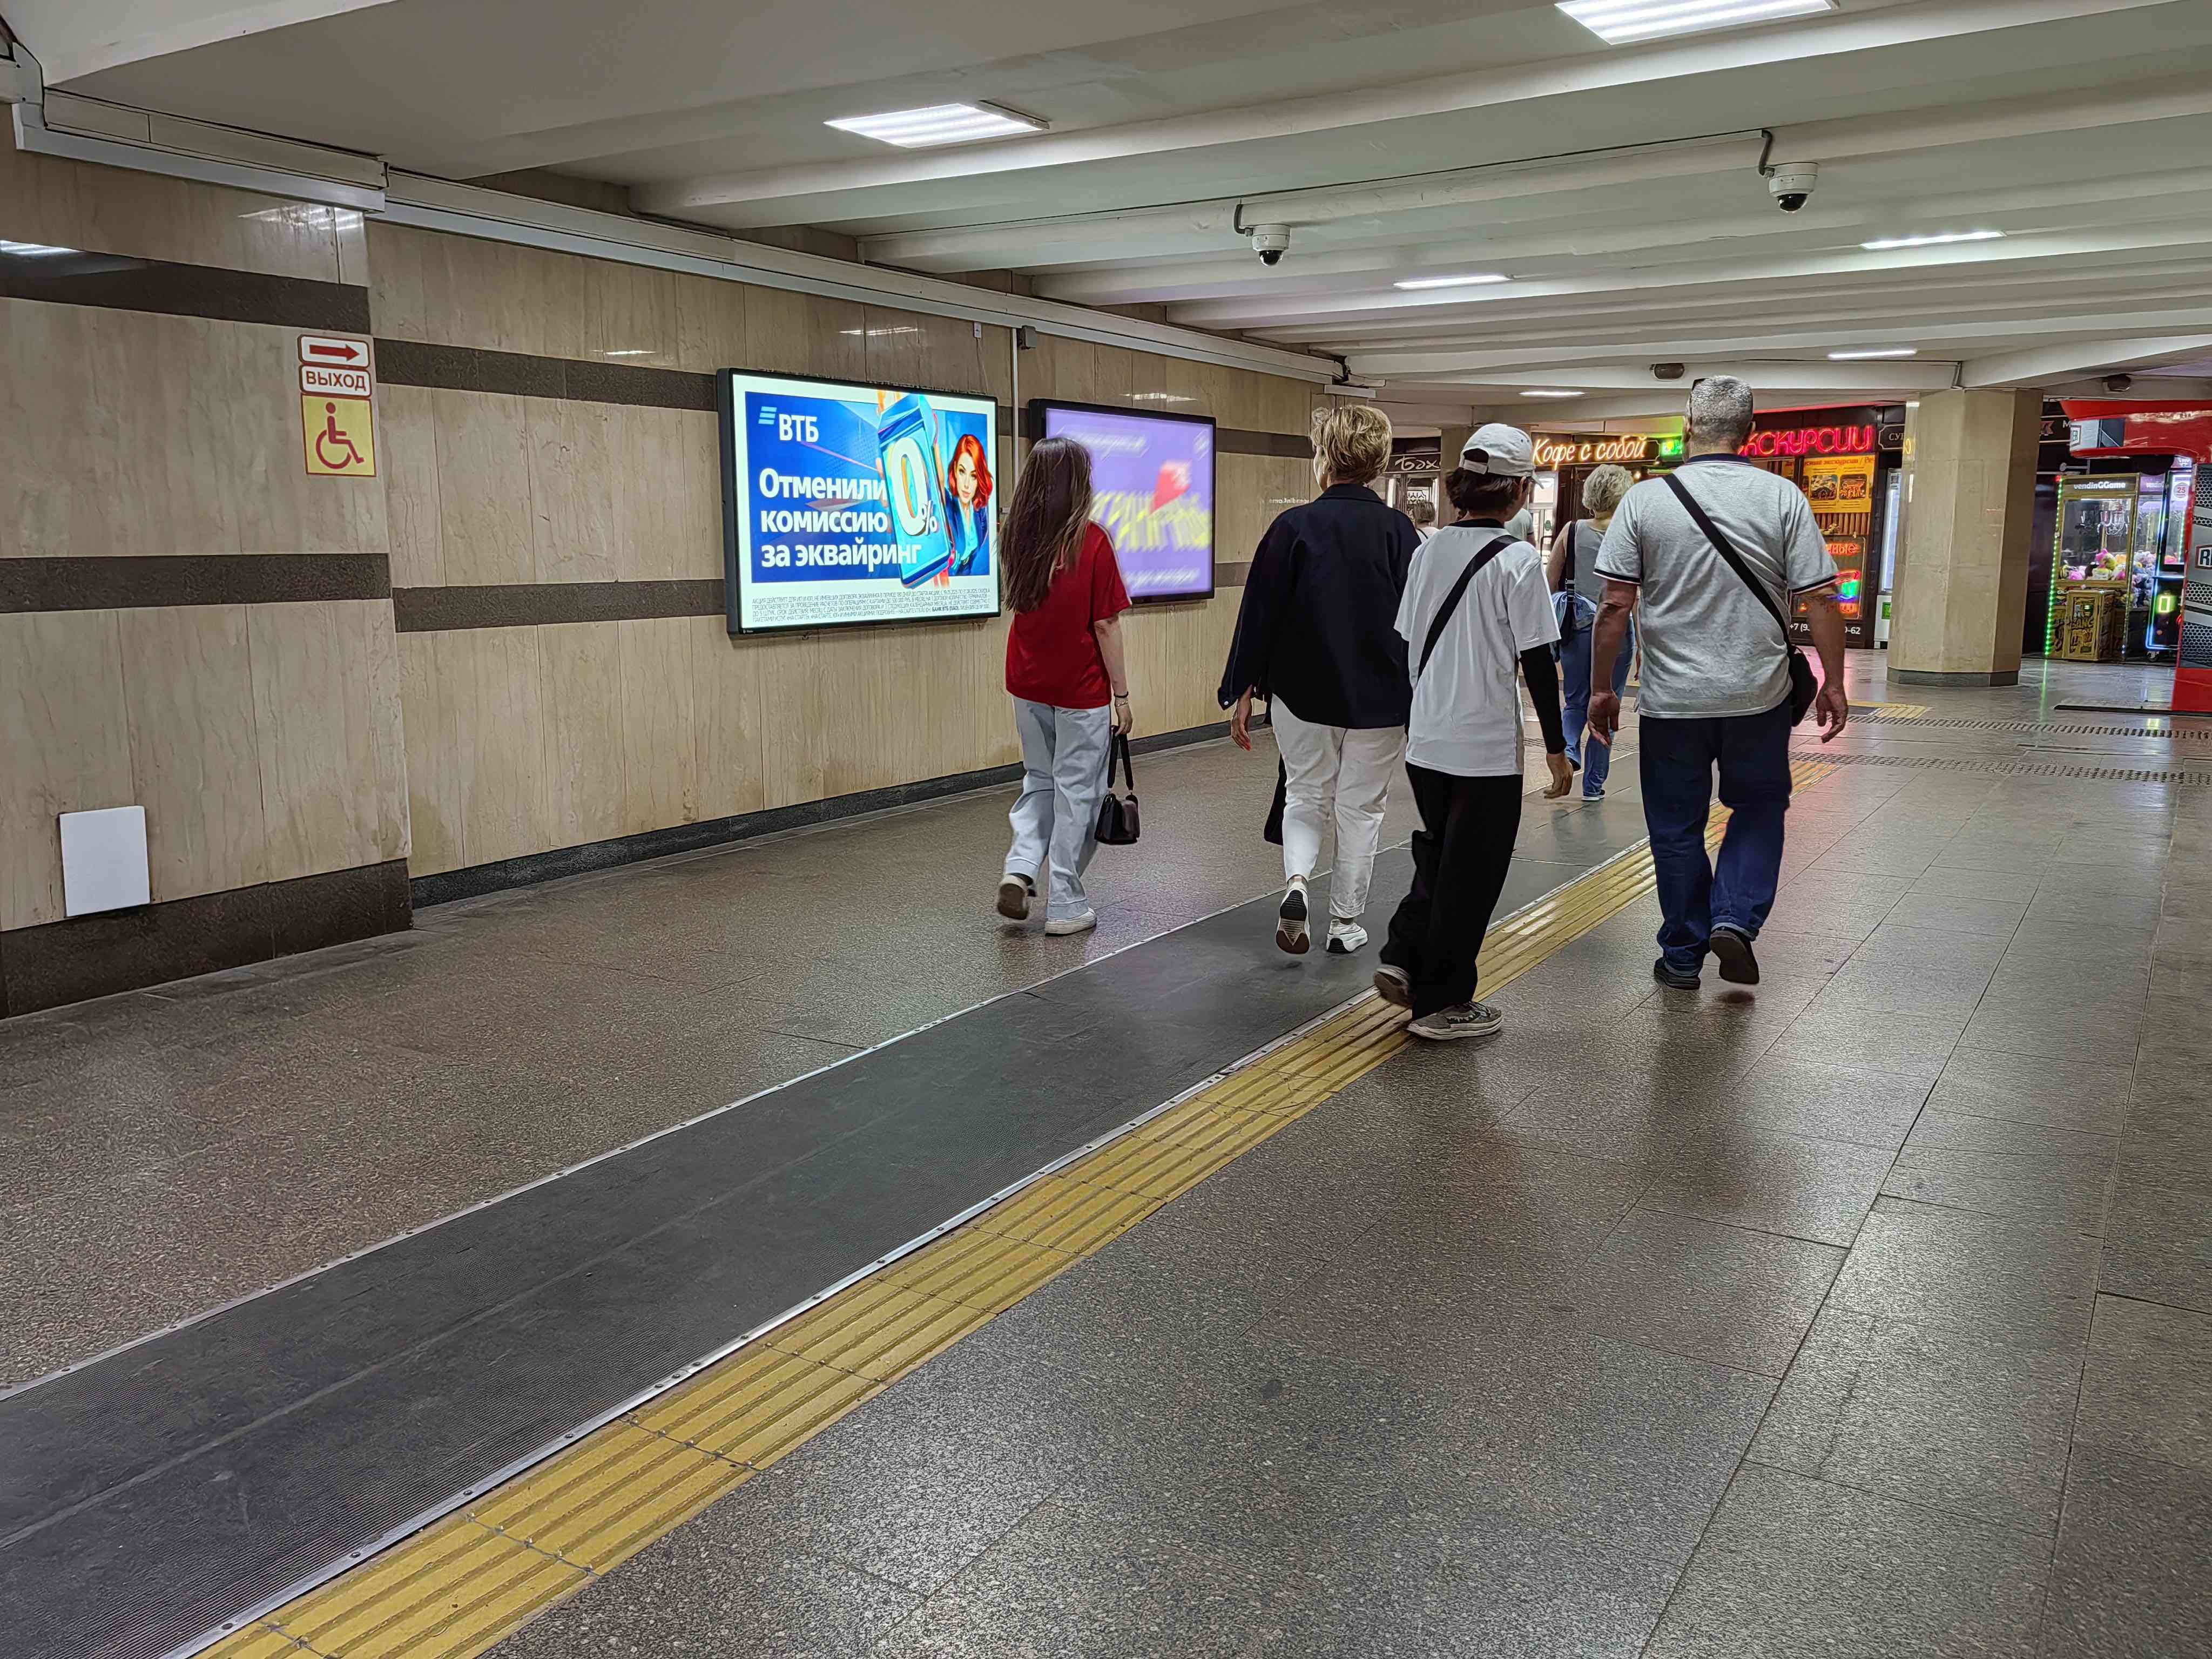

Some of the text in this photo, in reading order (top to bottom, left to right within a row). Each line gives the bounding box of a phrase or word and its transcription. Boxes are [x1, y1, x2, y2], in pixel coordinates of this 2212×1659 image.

[306, 371, 366, 391] ВЫХОД
[779, 414, 819, 443] ВТБ
[1738, 424, 1872, 455] КСКУРСИИ
[1533, 437, 1575, 471] Кофе
[1580, 443, 1591, 460] с
[1596, 435, 1647, 460] собой
[759, 468, 887, 501] Отменили
[761, 510, 888, 533] комиссию
[761, 536, 922, 572] за эквайринг
